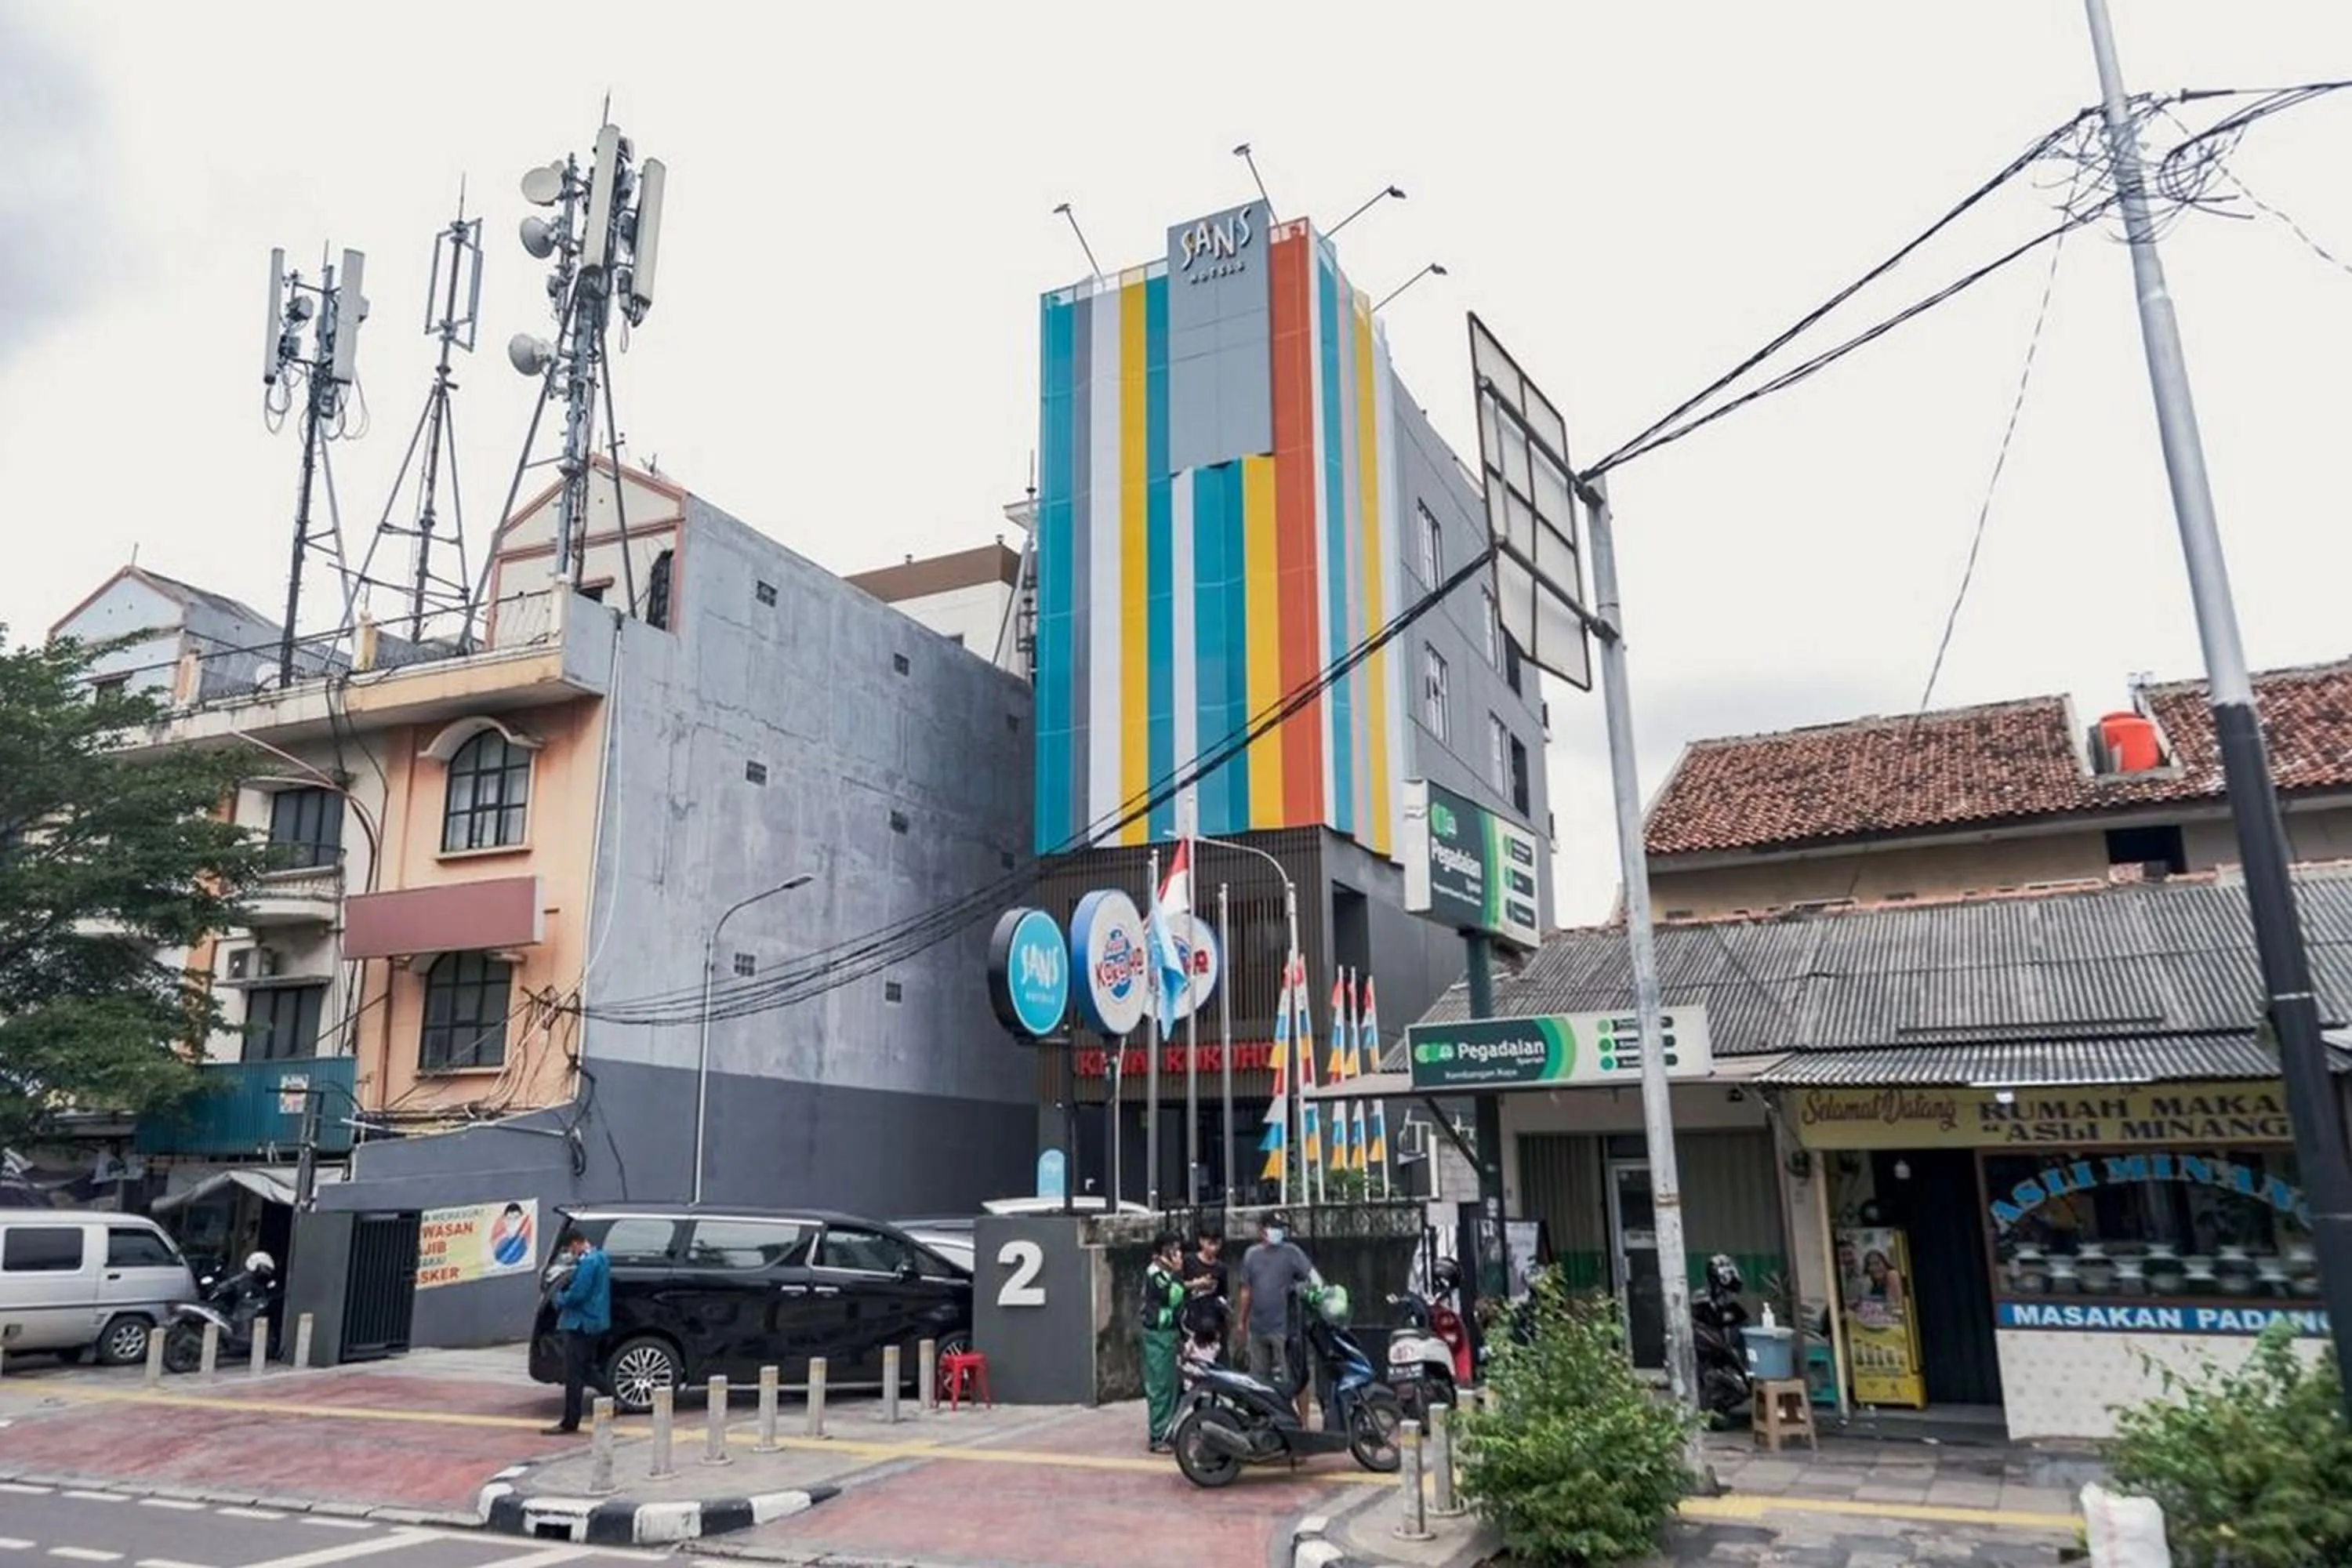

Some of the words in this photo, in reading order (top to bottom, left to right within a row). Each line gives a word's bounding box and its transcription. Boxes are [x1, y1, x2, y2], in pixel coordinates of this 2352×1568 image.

[1180, 205, 1252, 271] SANS
[1021, 943, 1059, 989] SANS
[1802, 1088, 1880, 1124] Selamat
[1882, 1087, 1958, 1131] Datang
[1979, 1098, 2129, 1121] RUMAH
[2152, 1095, 2281, 1117] MAKA
[2121, 1116, 2290, 1140] MINANG
[1989, 1160, 2098, 1234] ASLI
[423, 1222, 474, 1238] WASAN
[424, 1240, 447, 1256] JIB
[419, 1266, 460, 1284] SKER
[997, 1240, 1045, 1305] 2
[2012, 1304, 2183, 1328] MASAKAN
